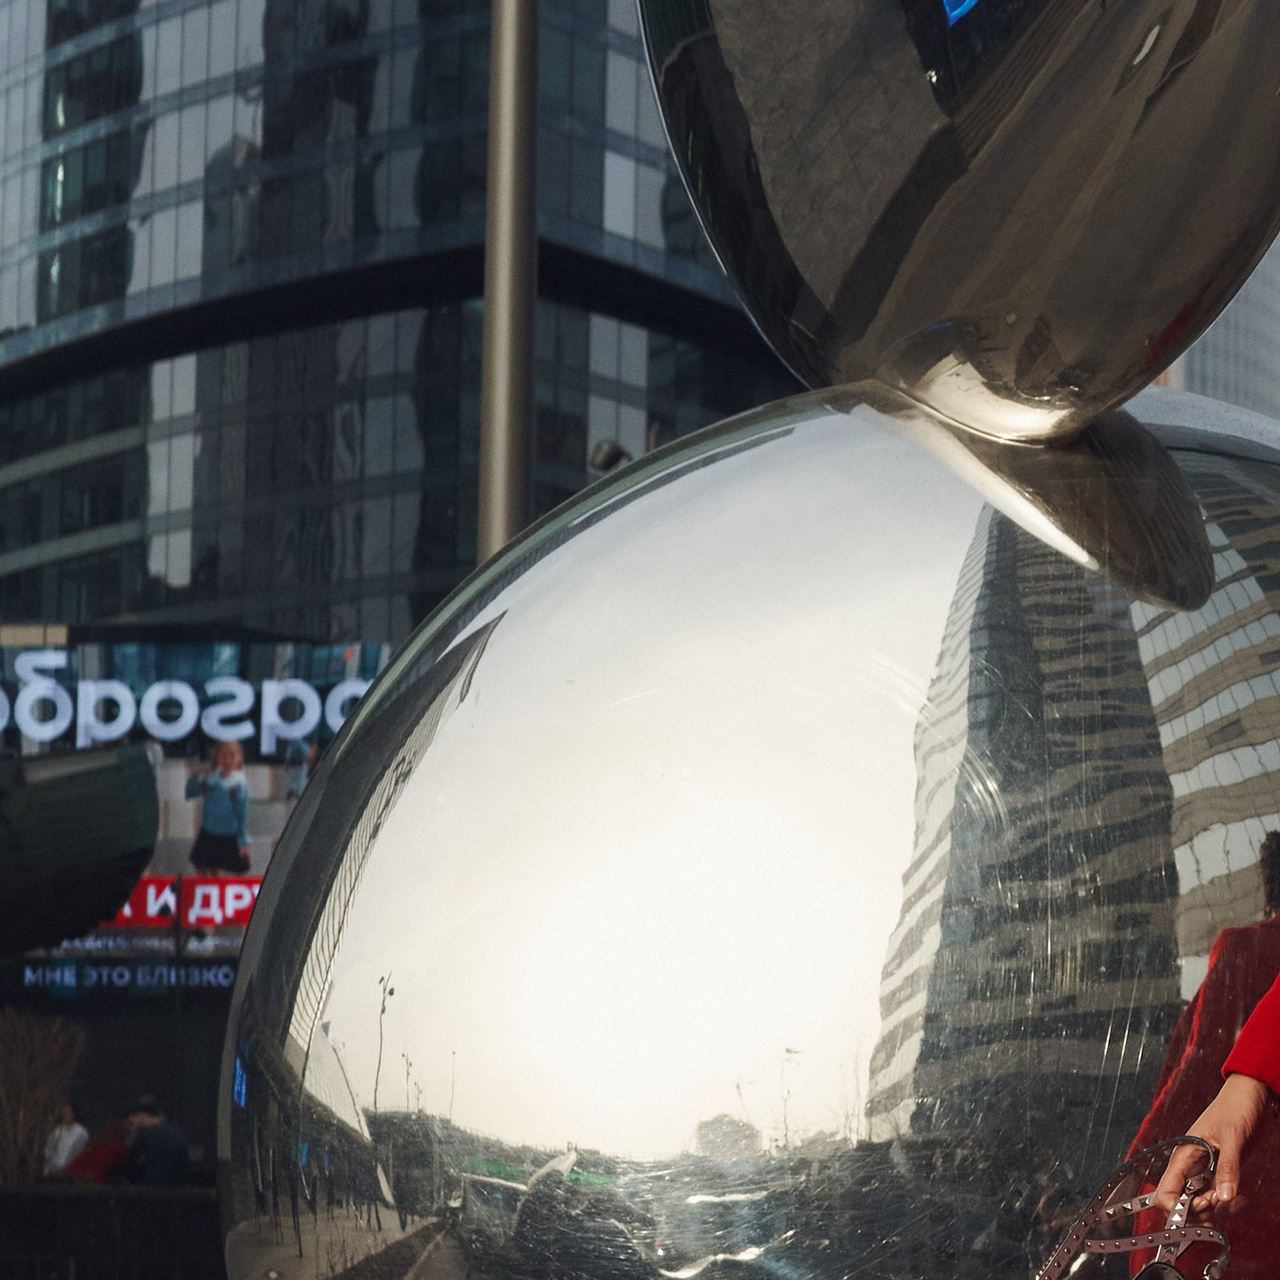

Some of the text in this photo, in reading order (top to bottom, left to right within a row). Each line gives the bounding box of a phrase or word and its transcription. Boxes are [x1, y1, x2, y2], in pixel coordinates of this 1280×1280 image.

[146, 884, 177, 918] И
[188, 884, 261, 924] ДР
[23, 965, 77, 987] МНЕ
[83, 965, 130, 987] ЭТО
